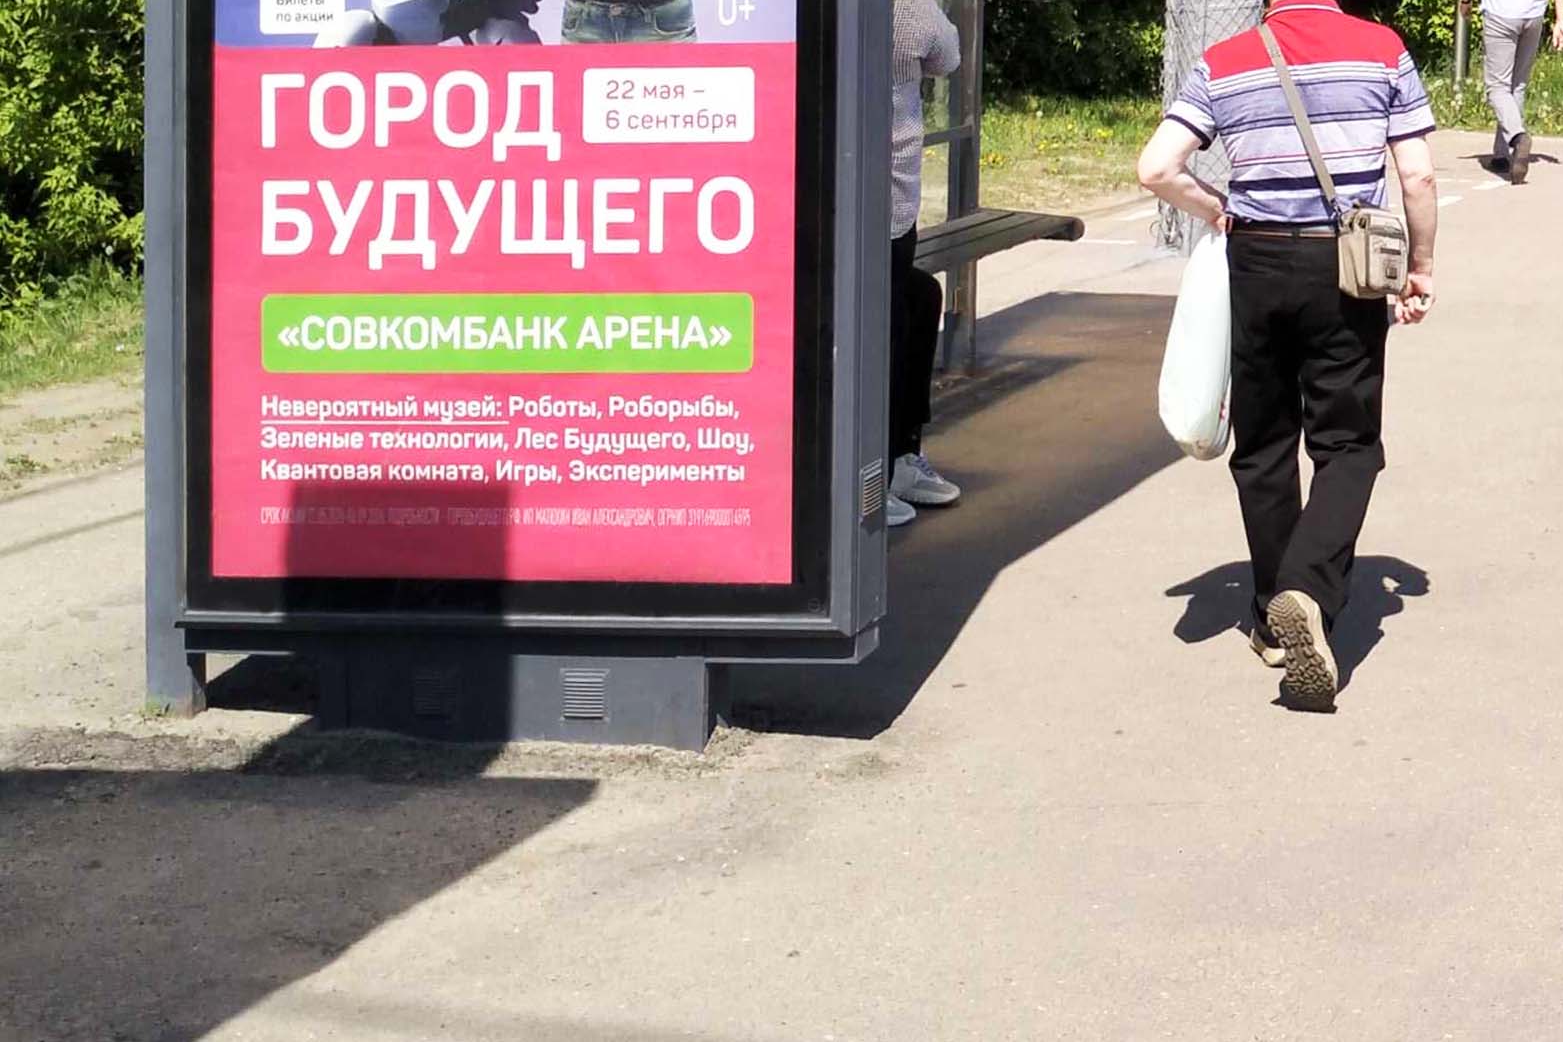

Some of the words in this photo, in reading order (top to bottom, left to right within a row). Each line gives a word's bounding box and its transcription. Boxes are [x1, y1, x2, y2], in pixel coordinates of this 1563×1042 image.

[276, 13, 291, 22] по
[295, 13, 333, 23] акции
[606, 80, 634, 100] 22
[643, 84, 685, 99] мая
[261, 70, 561, 162] ГОРОД
[606, 110, 620, 130] 6
[627, 108, 737, 134] сентября
[261, 176, 755, 270] БУДУЩЕГО
[278, 316, 568, 350] «СОВКОМБАНК
[575, 316, 733, 350] АРЕНА»
[261, 395, 418, 422] Невероятный
[423, 396, 502, 424] музей:
[508, 396, 603, 420] Роботы,
[608, 395, 740, 422] Роборыбы,
[260, 426, 364, 449] Зеленые
[369, 431, 509, 452] технологии,
[513, 427, 558, 449] Лес
[564, 427, 692, 455] Будущего,
[697, 426, 755, 455] Шоу,
[260, 458, 383, 481] Квантовая
[388, 464, 490, 484] комната,
[495, 459, 563, 487] Игры,
[568, 459, 745, 487] Эксперименты
